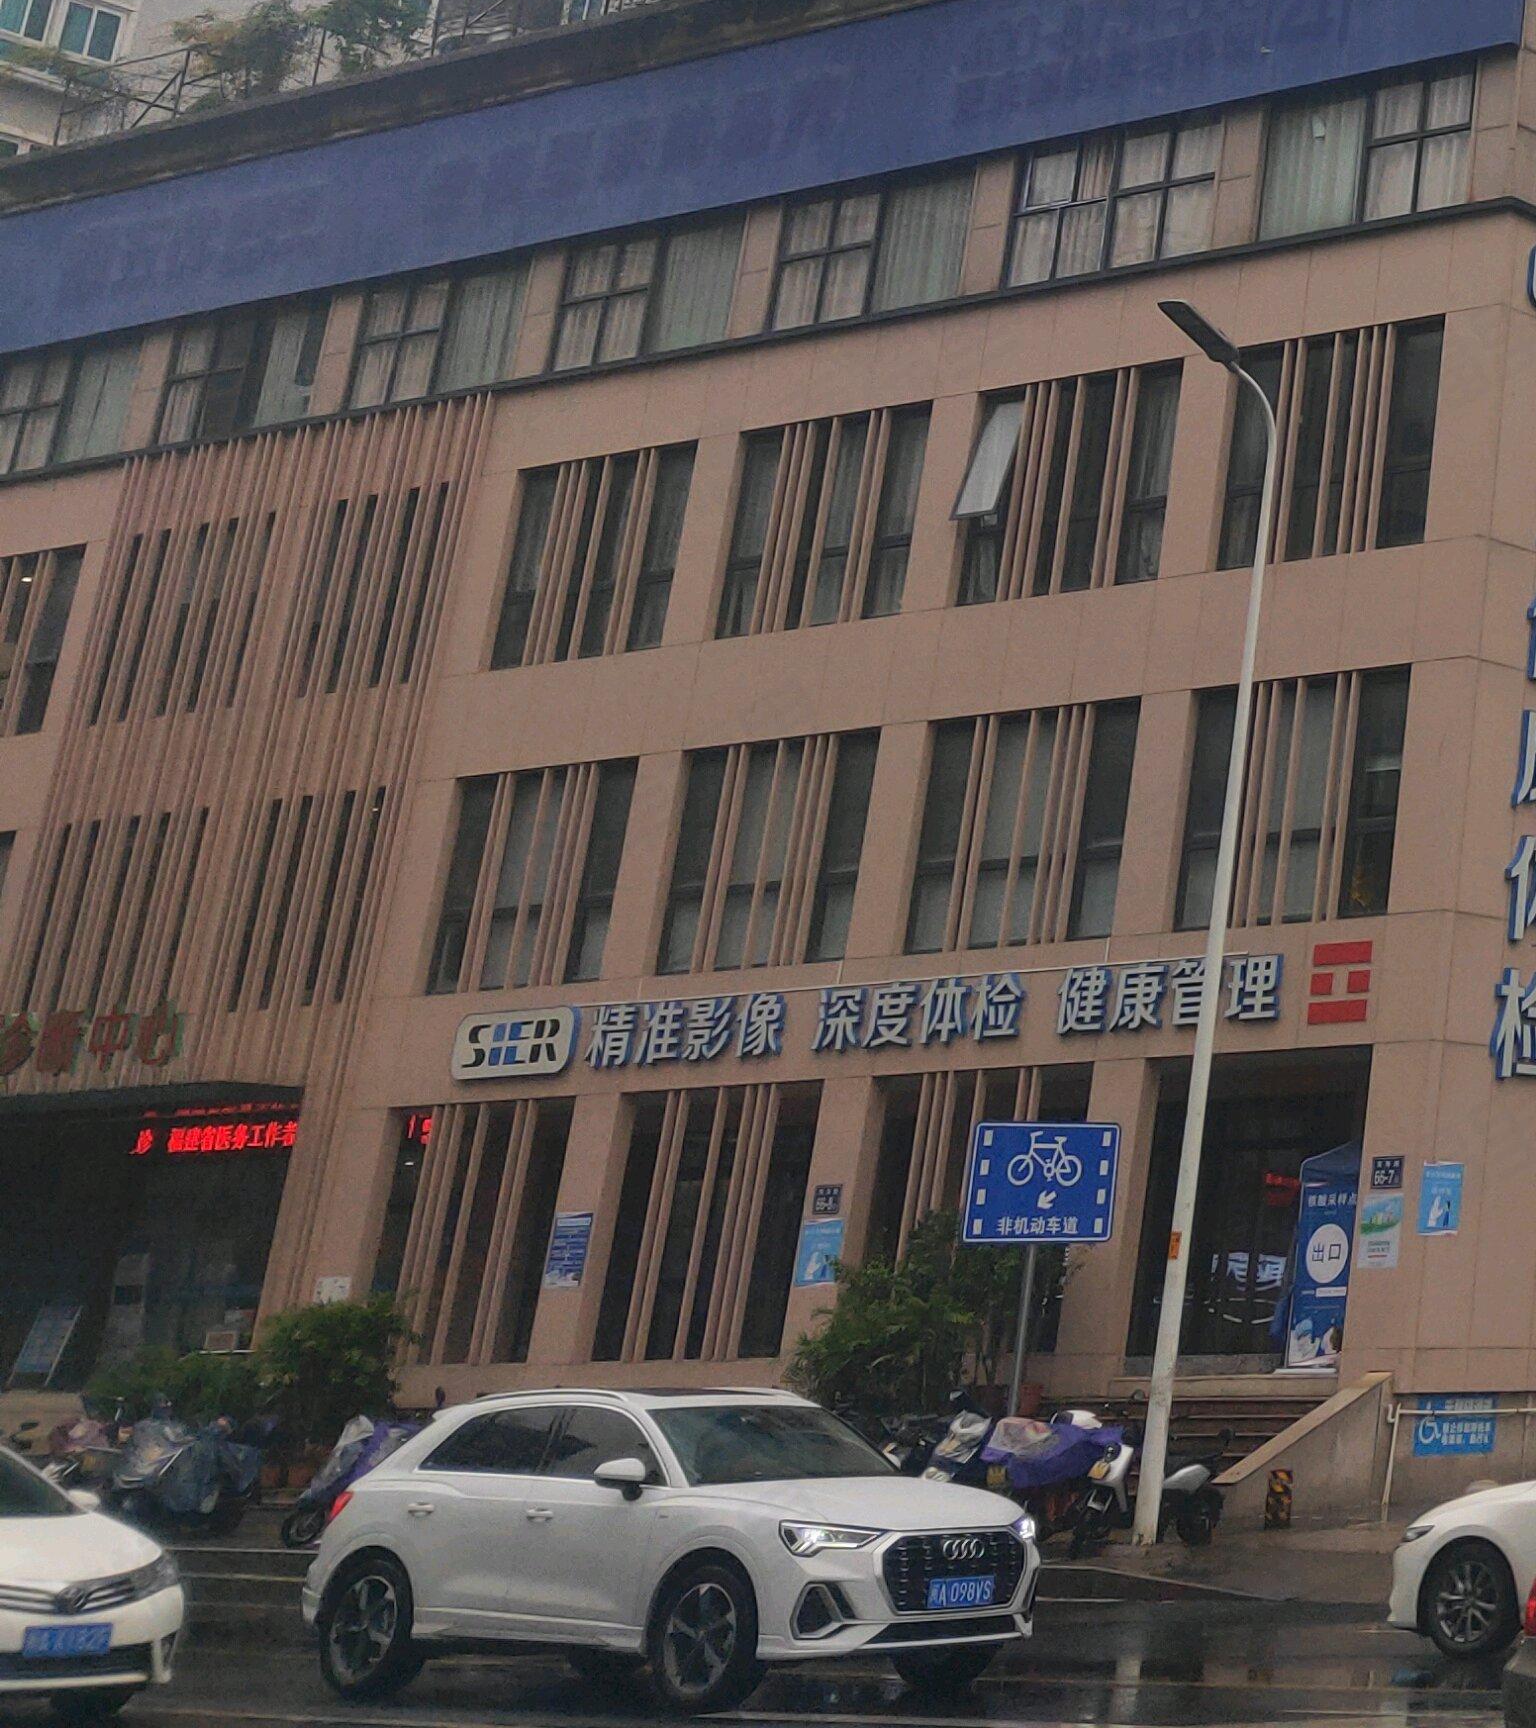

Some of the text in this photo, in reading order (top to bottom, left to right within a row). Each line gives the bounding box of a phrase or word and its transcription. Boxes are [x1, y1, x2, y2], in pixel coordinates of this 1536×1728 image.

[583, 993, 788, 1068] 精准影像
[810, 972, 1026, 1052] 深度体检
[1056, 953, 1284, 1035] 健康管理
[995, 1215, 1080, 1236] 非机动车道
[1311, 1242, 1342, 1264] 出口
